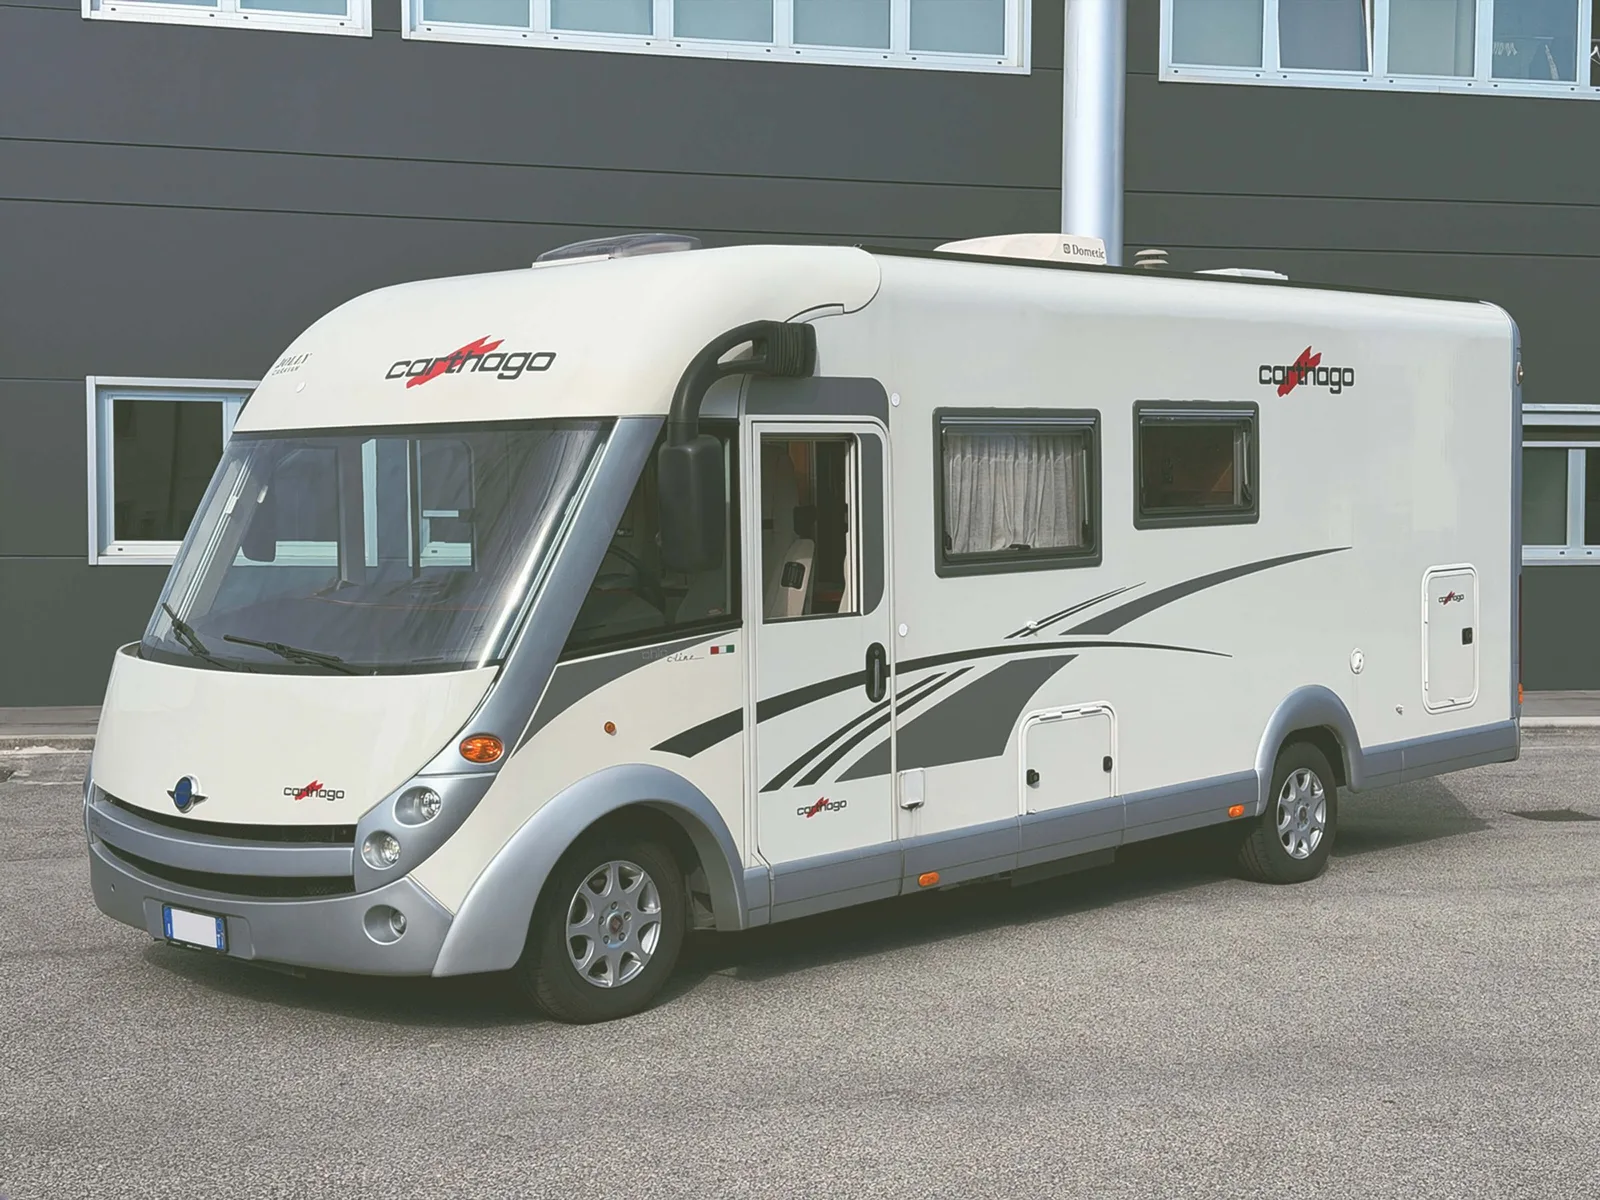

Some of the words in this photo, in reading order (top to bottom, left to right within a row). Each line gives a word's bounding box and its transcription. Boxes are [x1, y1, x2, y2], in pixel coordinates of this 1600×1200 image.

[1072, 244, 1105, 259] Dometic
[385, 345, 556, 381] carthago
[1259, 356, 1354, 394] carthago
[1438, 593, 1465, 604] caago
